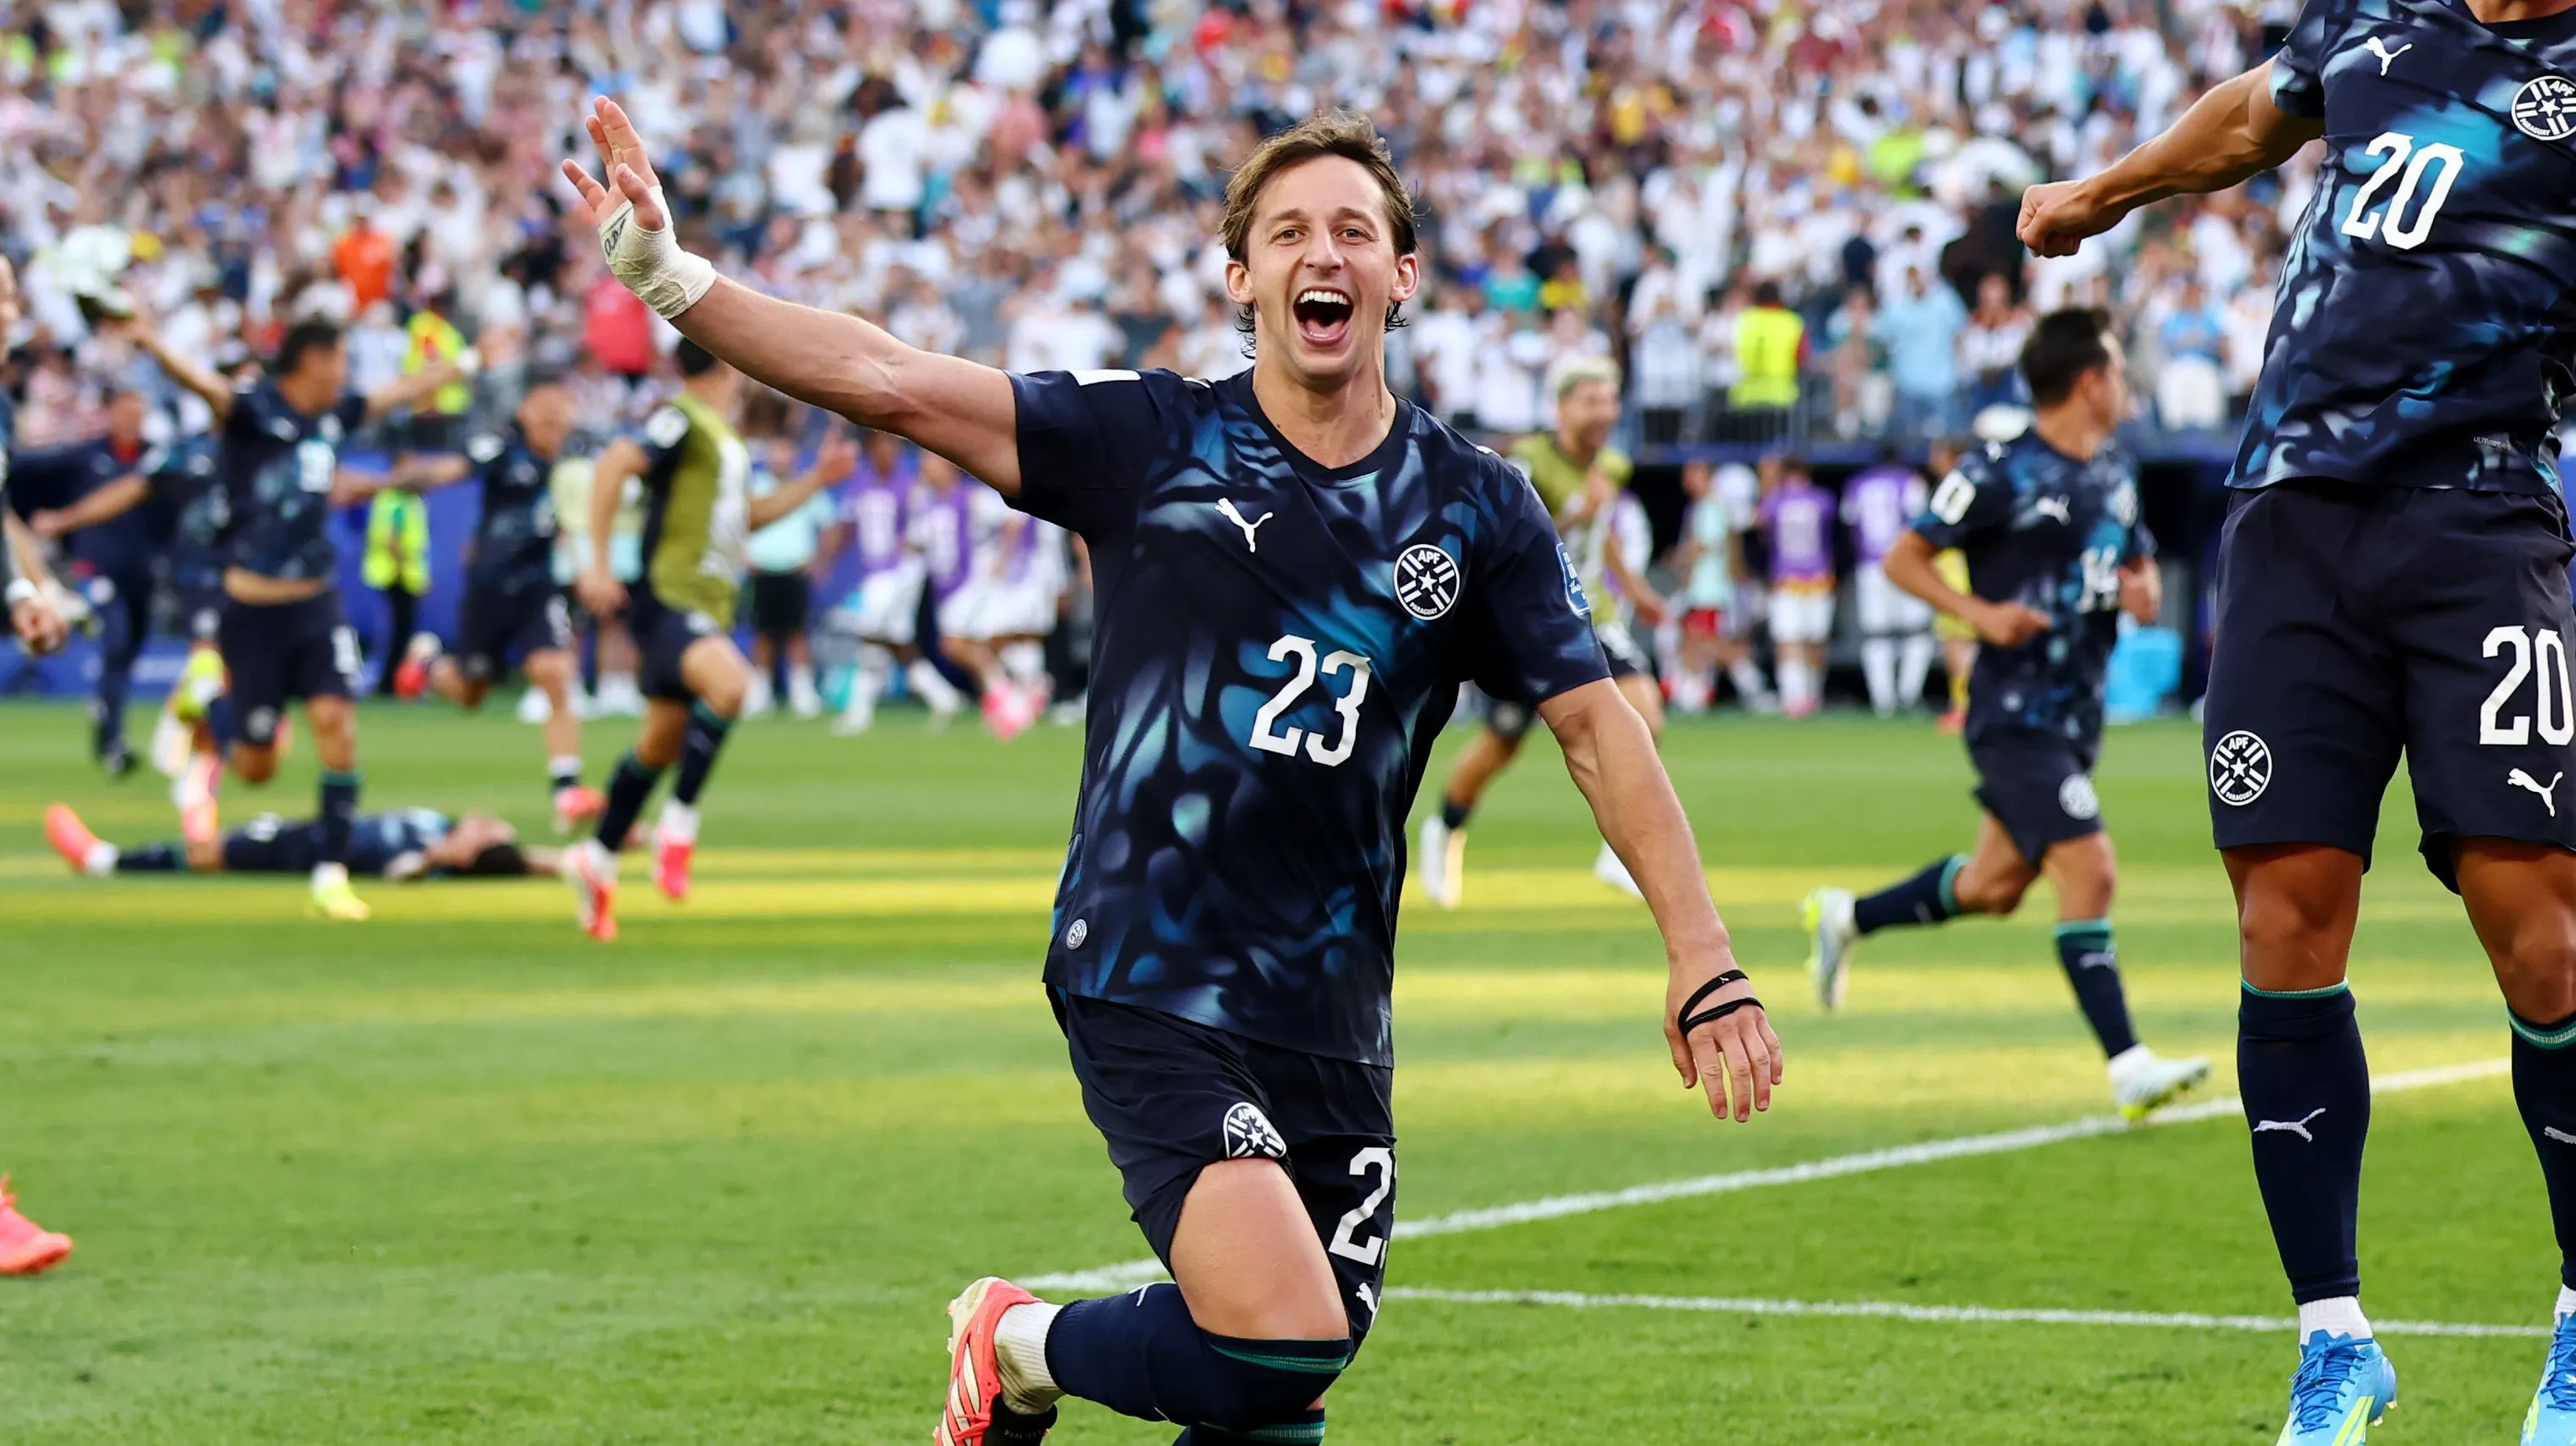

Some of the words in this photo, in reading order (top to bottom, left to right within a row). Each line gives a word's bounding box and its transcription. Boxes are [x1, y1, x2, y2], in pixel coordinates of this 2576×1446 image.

[2549, 80, 2575, 96] APF
[2342, 131, 2464, 250] 20
[1417, 550, 1440, 564] APF
[1250, 635, 1371, 767] 23
[2480, 625, 2575, 745] 20
[2228, 737, 2248, 750] APF
[2226, 789, 2253, 800] PARAGUAY
[1329, 1147, 1397, 1269] 2
